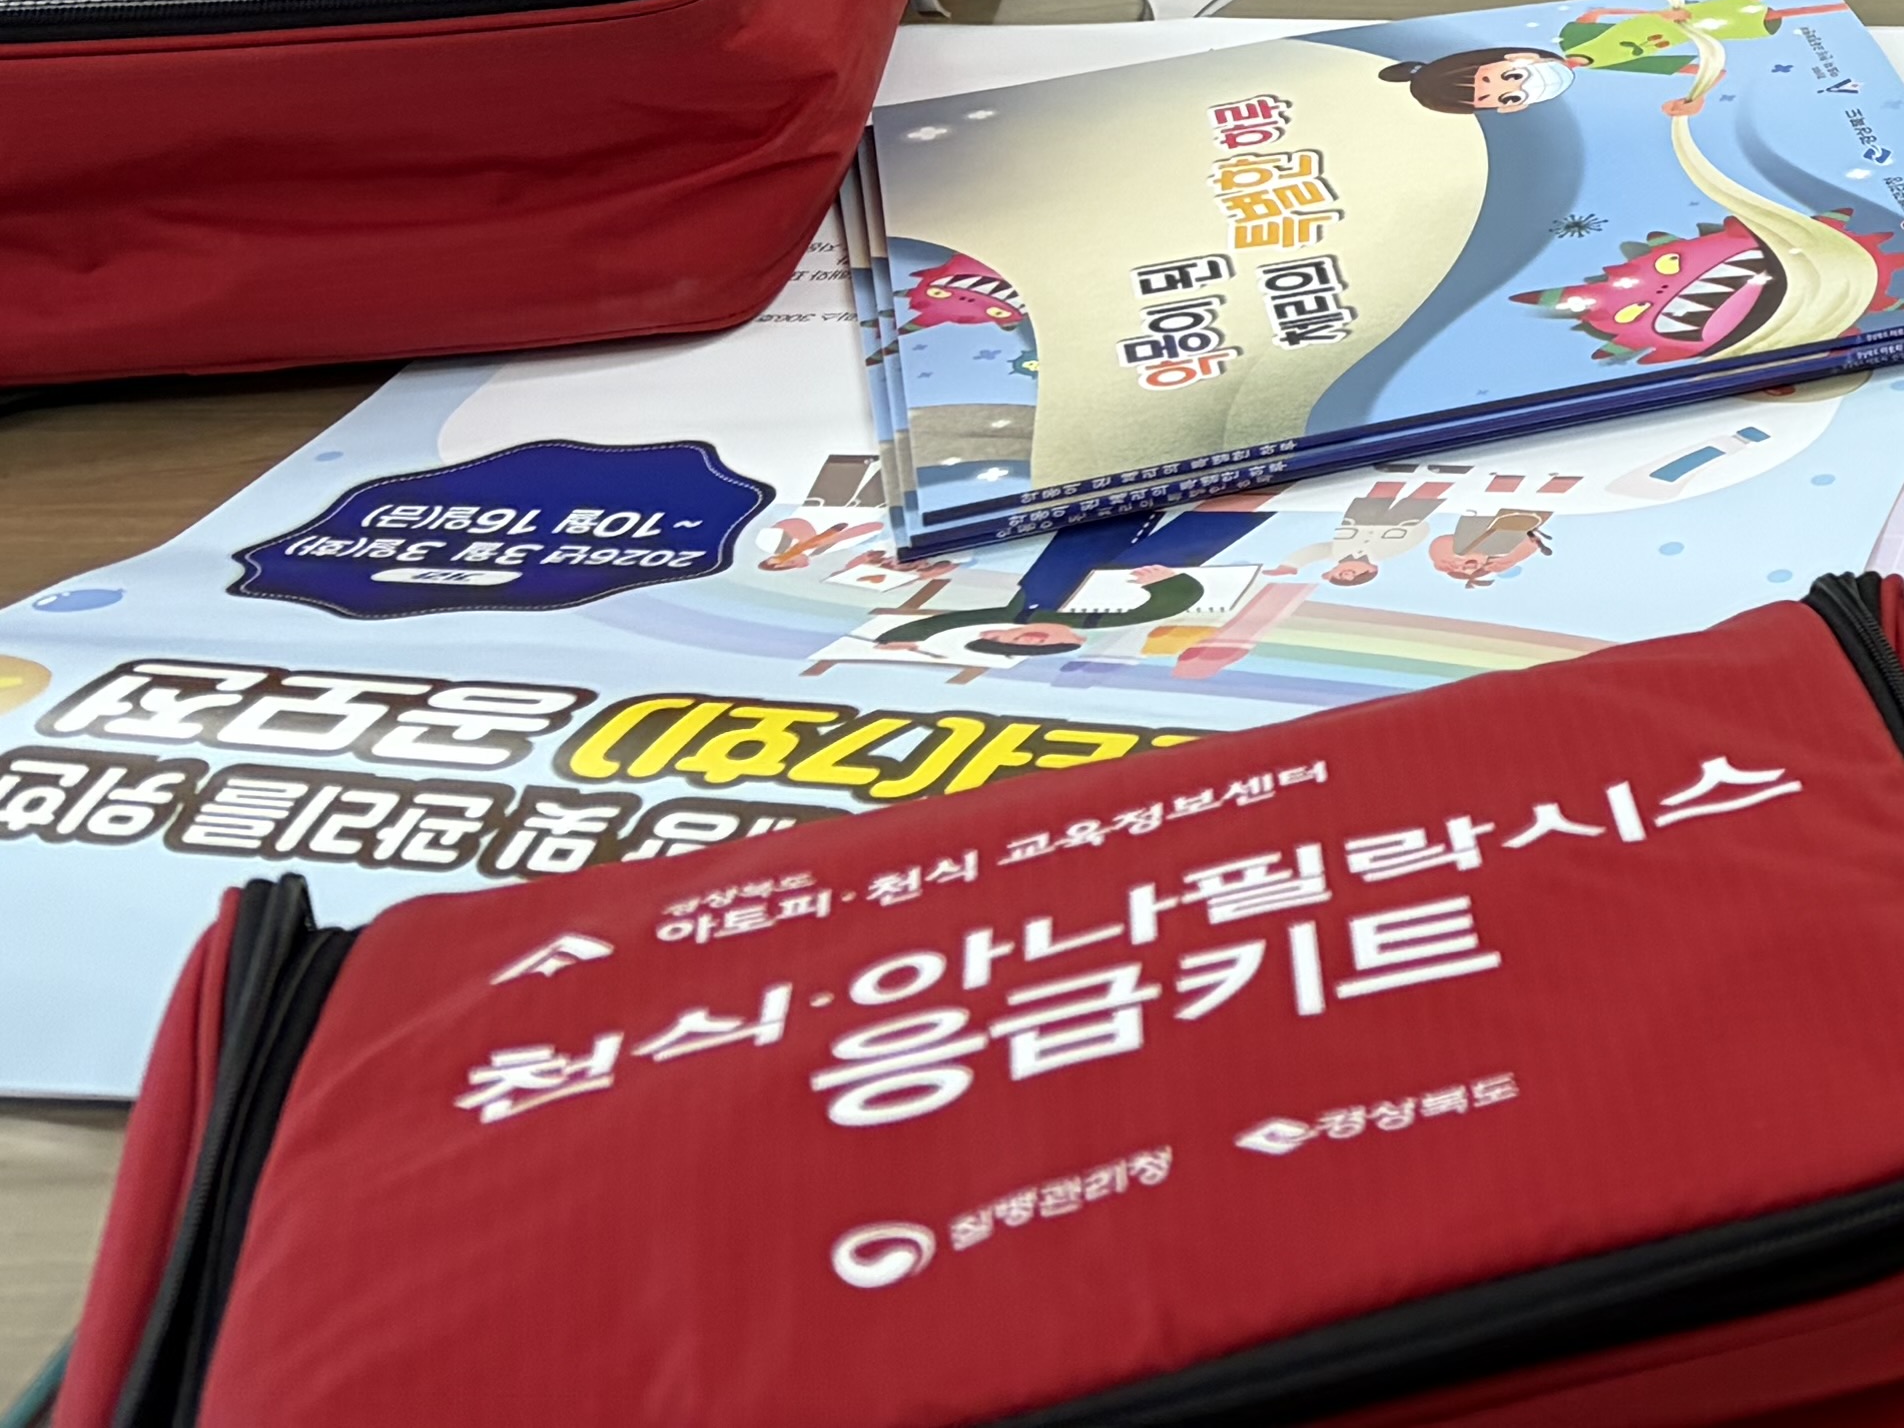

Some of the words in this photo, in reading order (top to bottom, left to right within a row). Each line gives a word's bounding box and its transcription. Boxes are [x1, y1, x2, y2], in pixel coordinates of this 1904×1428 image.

[1213, 98, 1281, 150] 하루
[1212, 153, 1333, 250] 특별한
[1136, 258, 1224, 295] 된
[1262, 259, 1345, 347] 체리의
[1121, 299, 1231, 388] 악몽이
[283, 535, 447, 562] 3일(화)
[360, 503, 542, 535] 16일(금)
[450, 540, 544, 565] 3월
[540, 544, 706, 568] 2026년
[53, 663, 579, 766] 공모전
[182, 778, 496, 864] 관리를
[496, 800, 603, 874] 및
[996, 760, 1329, 866] 교육정보센터
[807, 895, 1502, 1129] 응급키트
[1313, 1071, 1521, 1142] 경상북도
[948, 1145, 1174, 1253] 질병관리청
